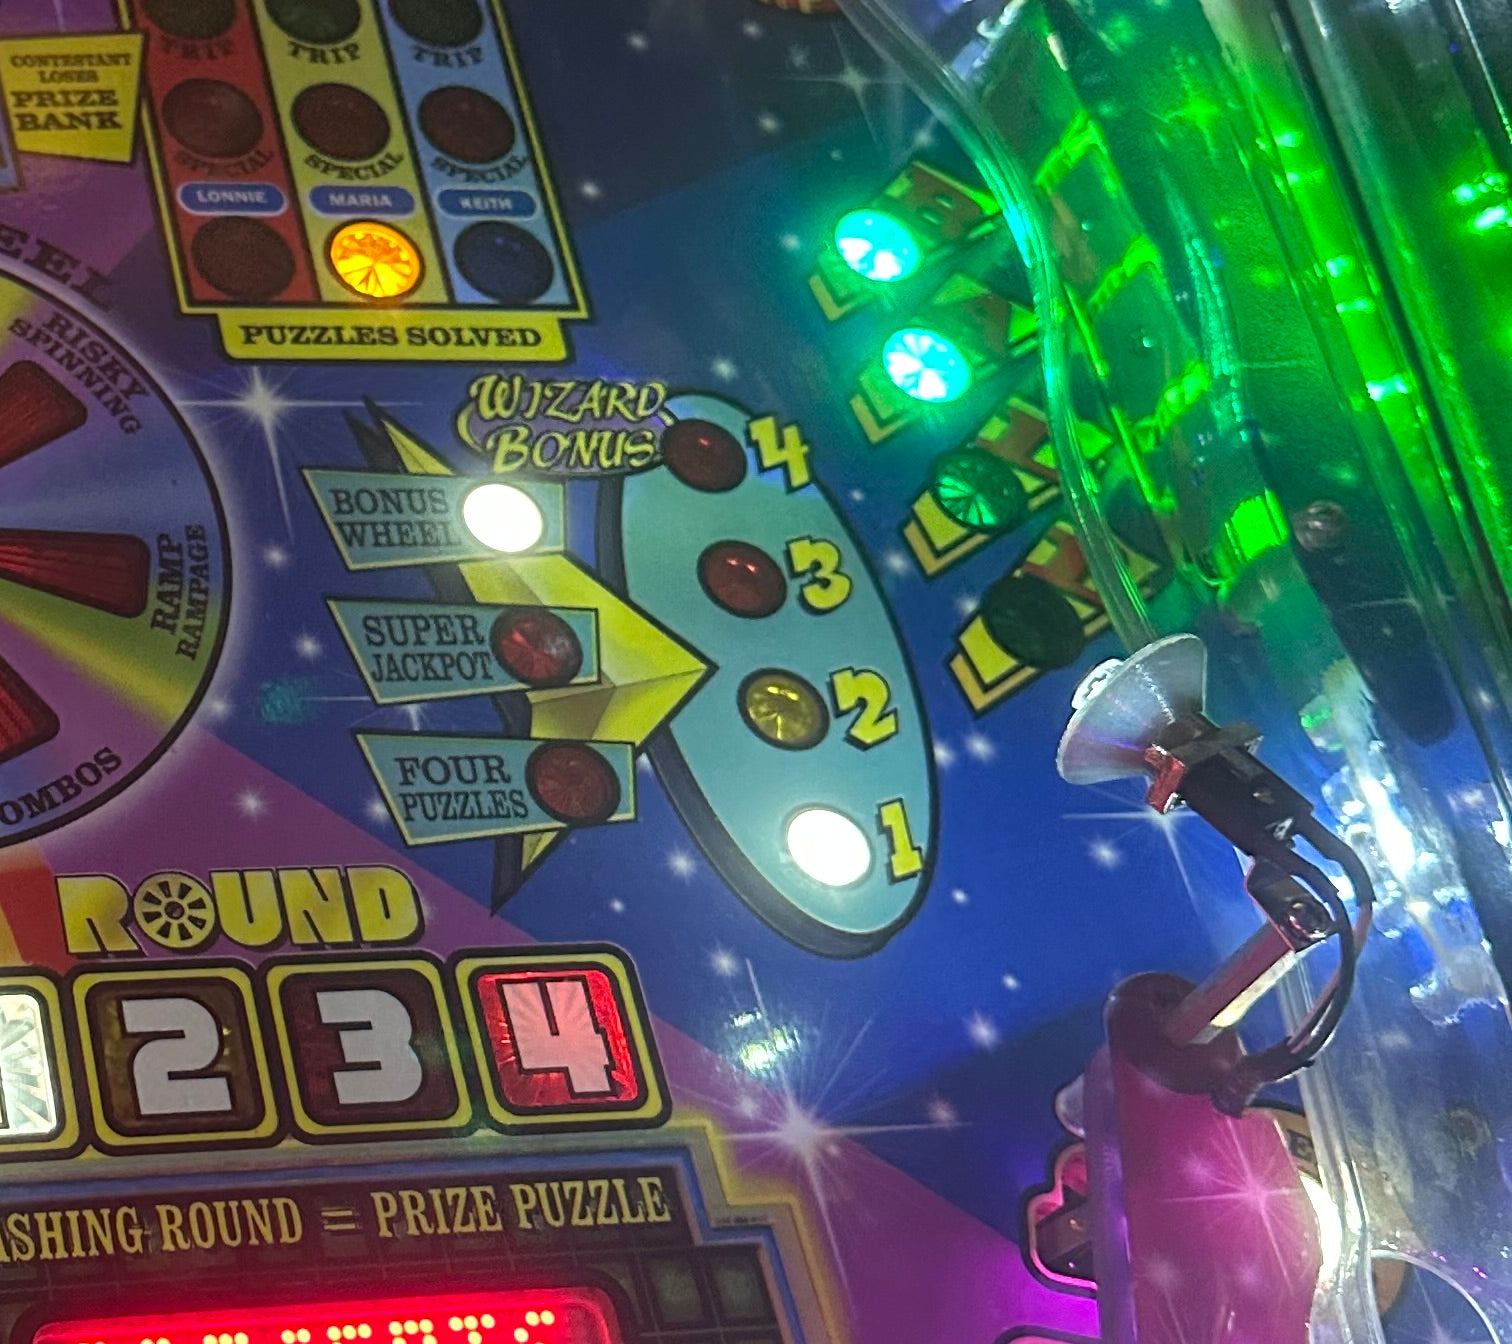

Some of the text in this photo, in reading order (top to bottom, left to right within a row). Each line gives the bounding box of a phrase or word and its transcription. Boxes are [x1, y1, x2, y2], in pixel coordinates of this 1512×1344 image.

[10, 52, 131, 69] CONTESTANT
[287, 41, 362, 66] TRIP
[411, 45, 486, 67] TRIP
[10, 89, 118, 109] PRIZE
[13, 111, 123, 133] BANK
[174, 149, 274, 178] SPECIAL
[302, 151, 405, 182] SPECIAL
[431, 153, 528, 184] SPECIAL
[196, 189, 269, 207] LONNIE
[328, 192, 393, 209] MARIA
[459, 196, 513, 212] KEITH
[240, 324, 543, 348] PUZZLES SOLVED
[44, 311, 151, 404] RISKY
[7, 316, 144, 438] SPINNING
[469, 372, 669, 423] WIZARD
[486, 423, 661, 474] BONUS
[747, 414, 818, 490] 4
[329, 488, 450, 518] BONUS
[341, 519, 466, 549] WHEEL
[149, 532, 185, 637] RAMP
[176, 524, 208, 662] RAMPAGE
[786, 536, 853, 615] 3
[363, 614, 485, 648] SUPER
[371, 648, 493, 683] JACKPOT
[828, 666, 898, 750] 2
[394, 755, 512, 788] FOUR
[401, 787, 529, 823] PUZZLES
[877, 797, 923, 882] 1
[54, 863, 428, 958] ROUND
[314, 987, 422, 1106] 3
[499, 974, 620, 1099] 4
[119, 997, 235, 1116] 2
[155, 1196, 305, 1253] ROUND
[370, 1184, 504, 1240] PRIZE
[514, 1175, 672, 1230] PUZZLE
